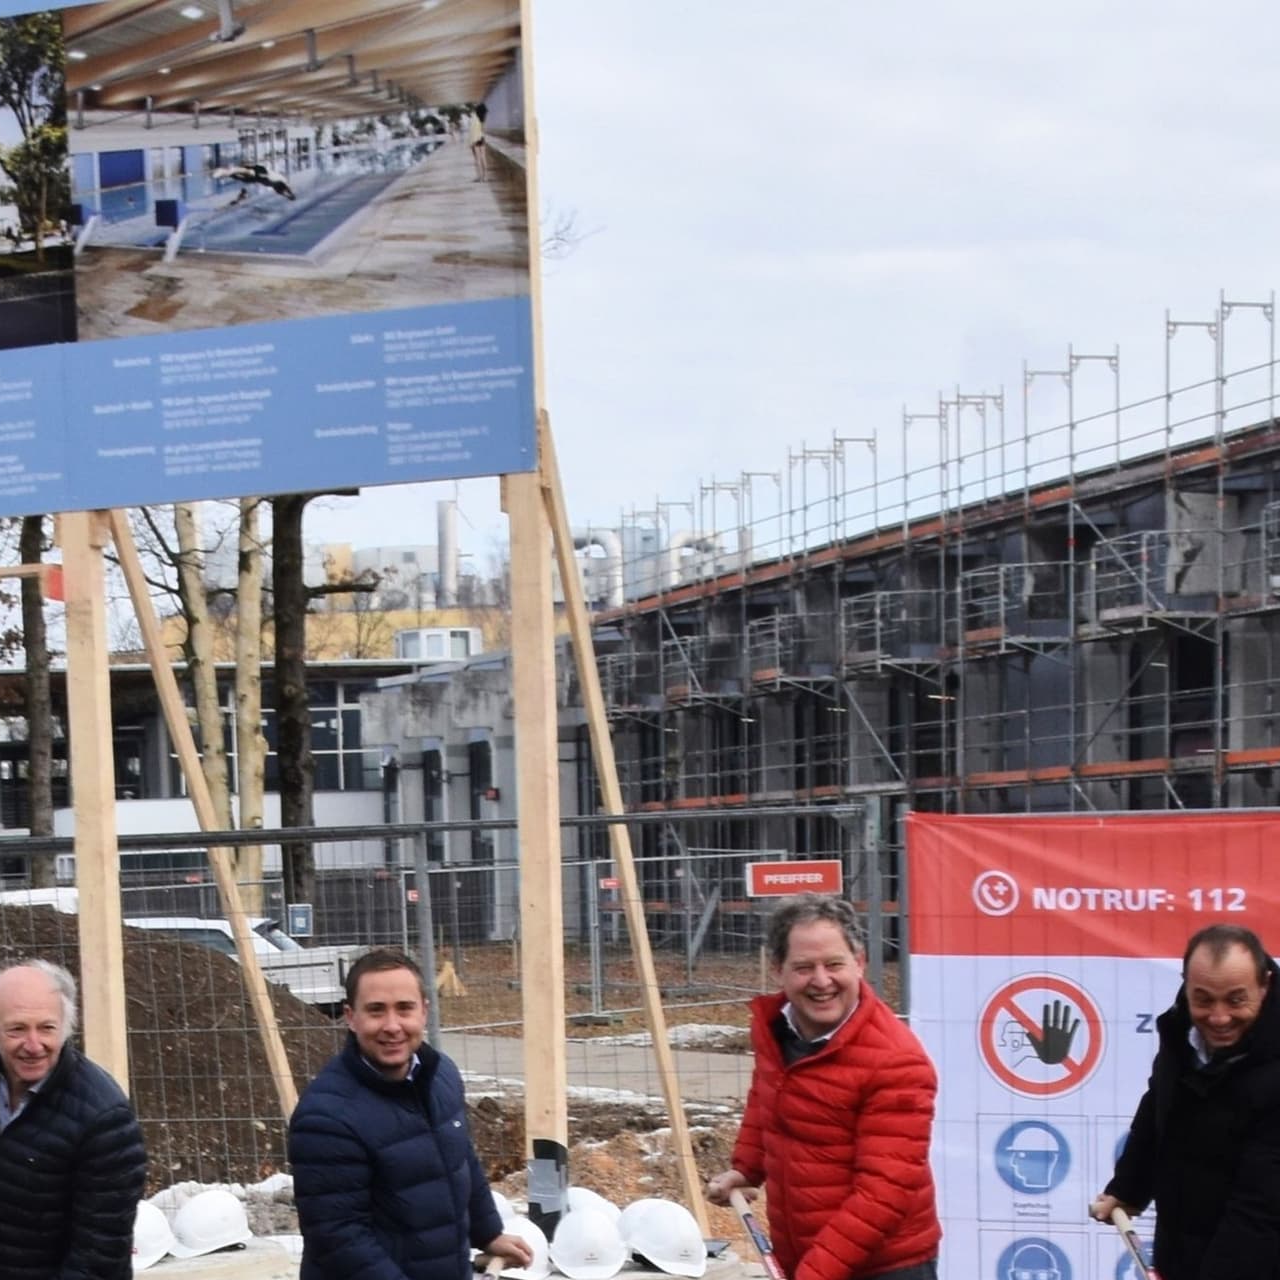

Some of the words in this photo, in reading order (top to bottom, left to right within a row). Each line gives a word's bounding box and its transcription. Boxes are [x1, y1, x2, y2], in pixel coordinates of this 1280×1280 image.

[763, 872, 825, 886] PFEIFFER
[1032, 887, 1175, 911] NOTRUF:
[1188, 887, 1247, 912] 112
